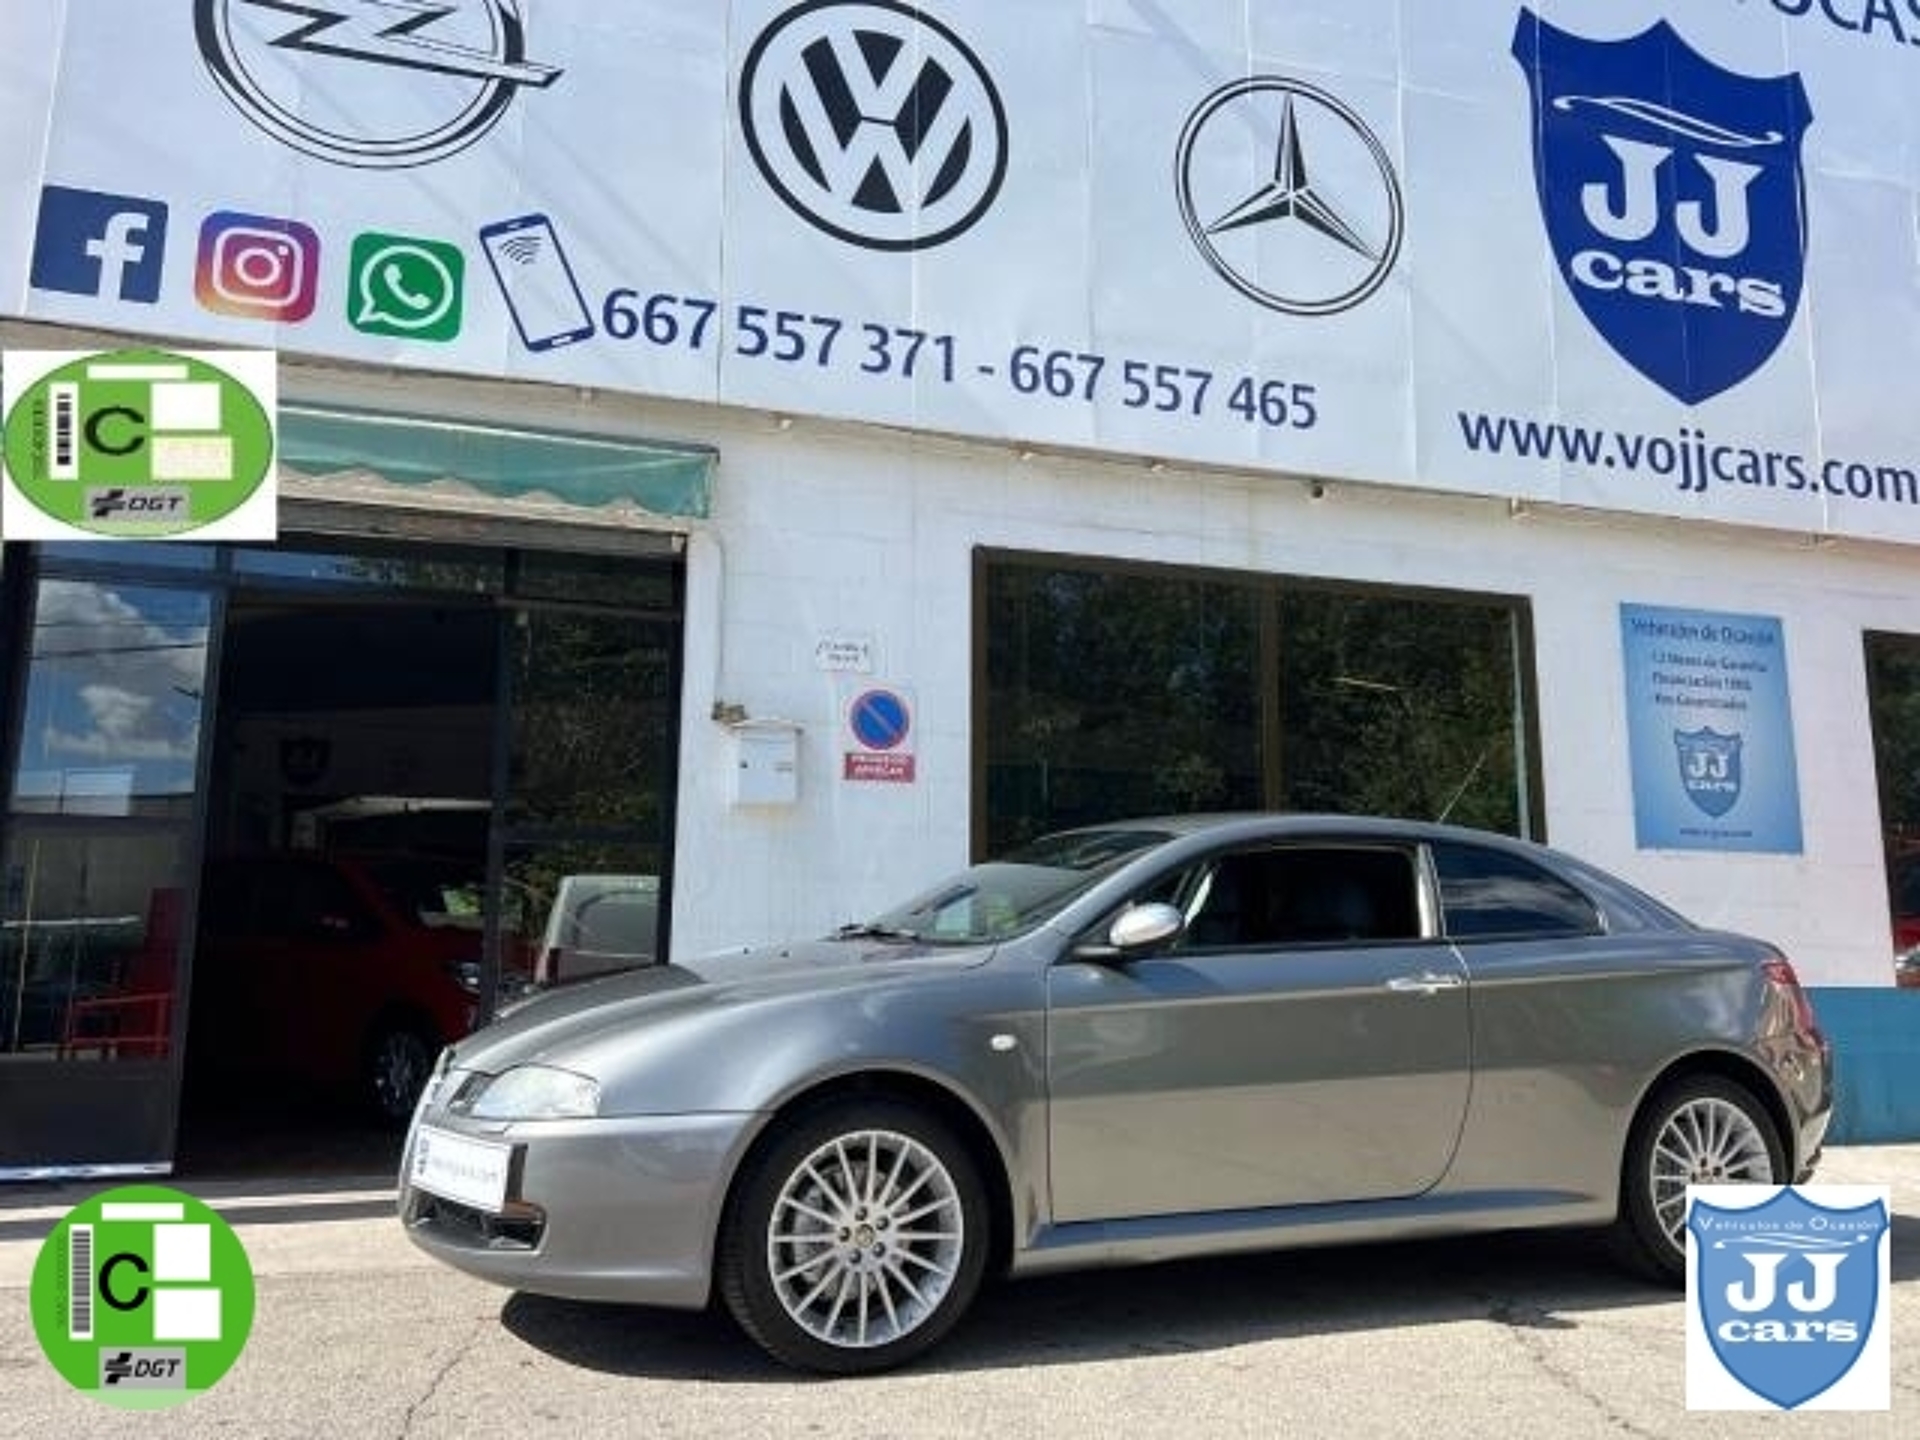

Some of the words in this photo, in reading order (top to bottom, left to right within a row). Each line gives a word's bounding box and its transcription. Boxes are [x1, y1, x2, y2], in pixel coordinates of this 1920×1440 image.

[1581, 134, 1763, 259] JJ
[1571, 250, 1786, 317] cars
[602, 288, 717, 349] 667
[736, 306, 842, 366] 557
[860, 323, 955, 382] 371
[1010, 345, 1105, 401] 667
[1123, 360, 1212, 415] 557
[1227, 377, 1317, 429] 465
[1459, 411, 1919, 505] www.vojjcars.com
